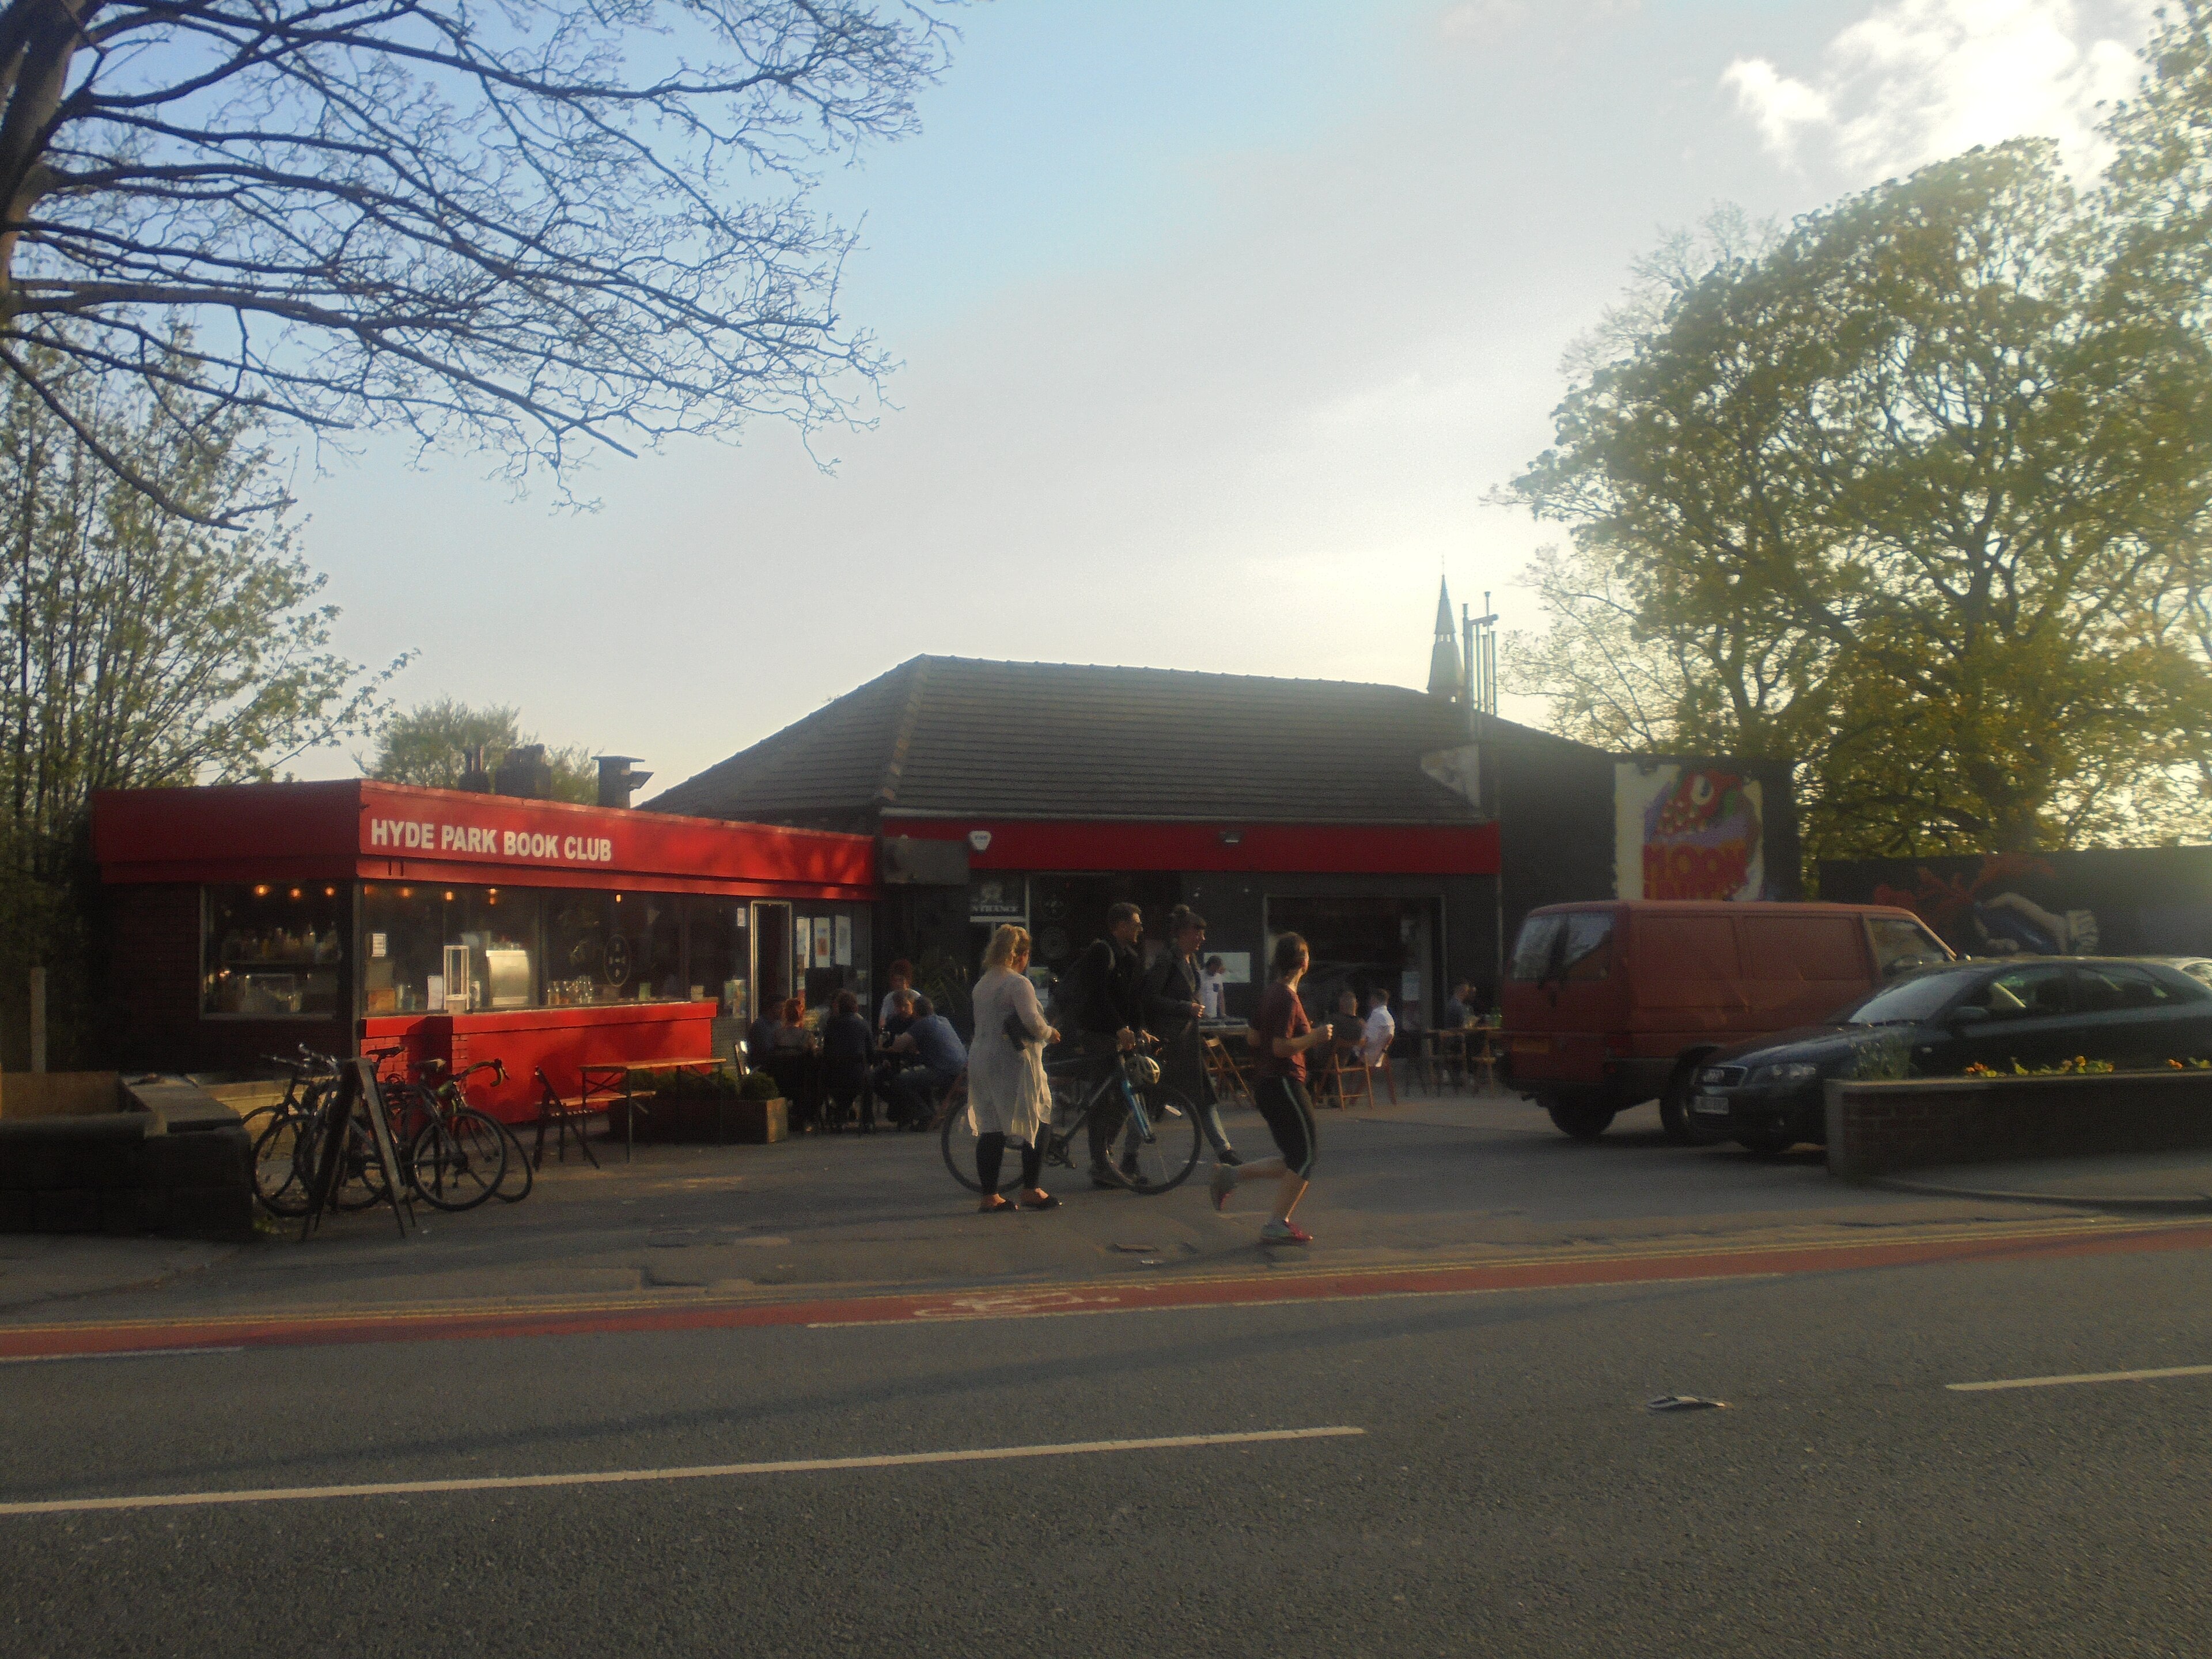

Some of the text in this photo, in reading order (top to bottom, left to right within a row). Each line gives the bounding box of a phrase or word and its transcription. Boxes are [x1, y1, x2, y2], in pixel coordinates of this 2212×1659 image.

[371, 819, 612, 862] HYDE PARK BOOK CLUB
